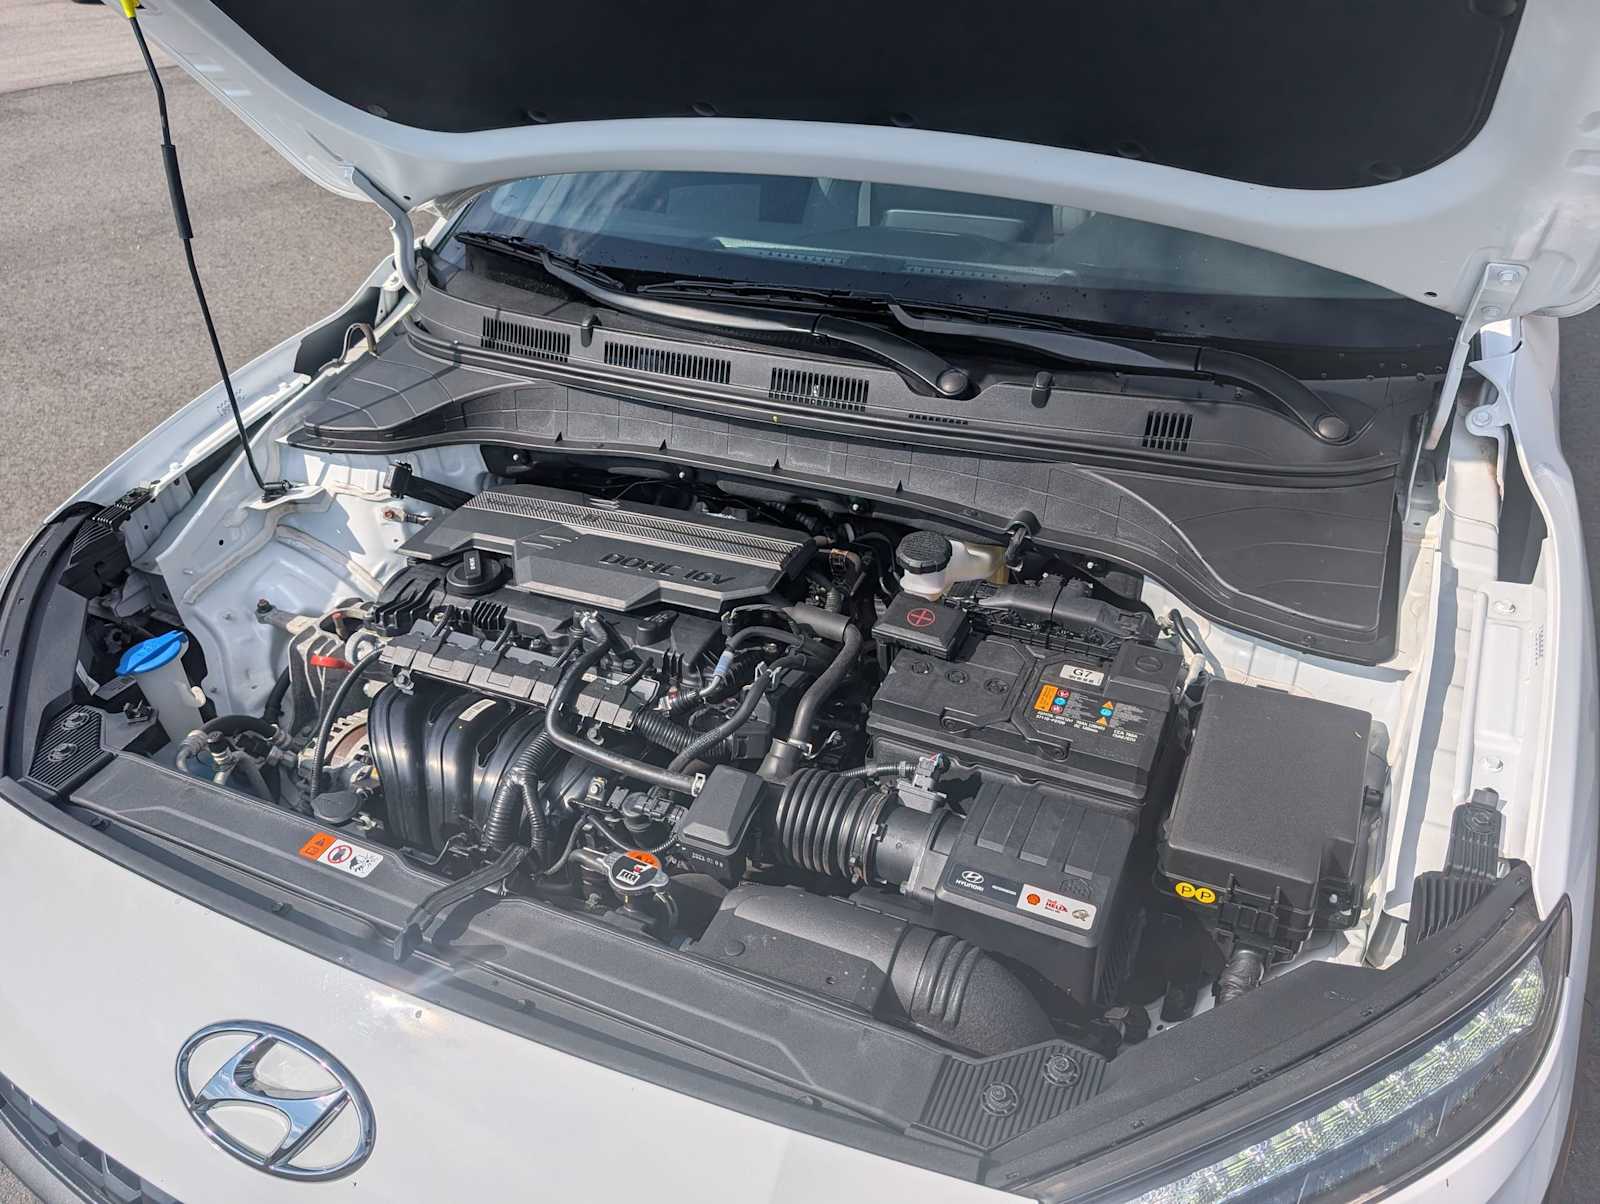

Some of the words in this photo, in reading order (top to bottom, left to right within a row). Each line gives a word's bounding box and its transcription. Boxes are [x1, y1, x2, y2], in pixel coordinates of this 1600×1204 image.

[600, 552, 683, 577] DOHC
[683, 567, 736, 585] 16V
[1072, 668, 1093, 678] G7
[955, 879, 985, 891] HYUNDAI
